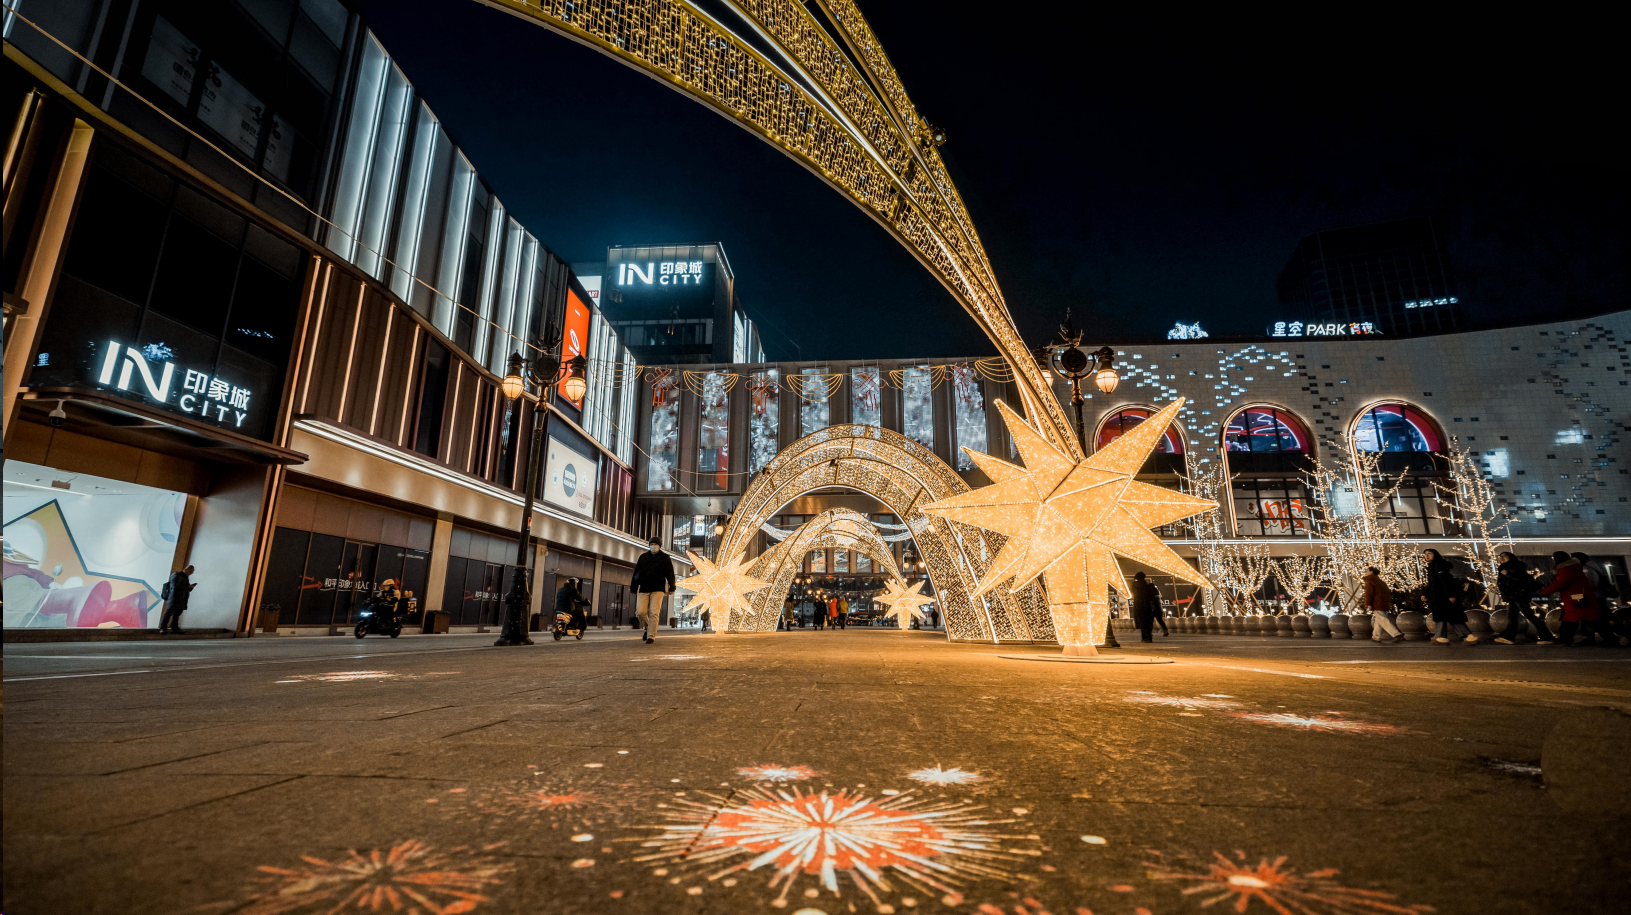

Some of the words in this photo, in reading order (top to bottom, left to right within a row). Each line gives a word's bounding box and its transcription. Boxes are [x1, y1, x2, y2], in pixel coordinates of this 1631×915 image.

[618, 262, 655, 285] IN
[659, 274, 703, 285] CITY
[660, 261, 703, 275] 印象城
[1272, 321, 1304, 337] 星空
[1306, 323, 1347, 336] PARK
[98, 340, 175, 403] IN
[183, 368, 252, 411] 印象城
[180, 394, 248, 428] CITY
